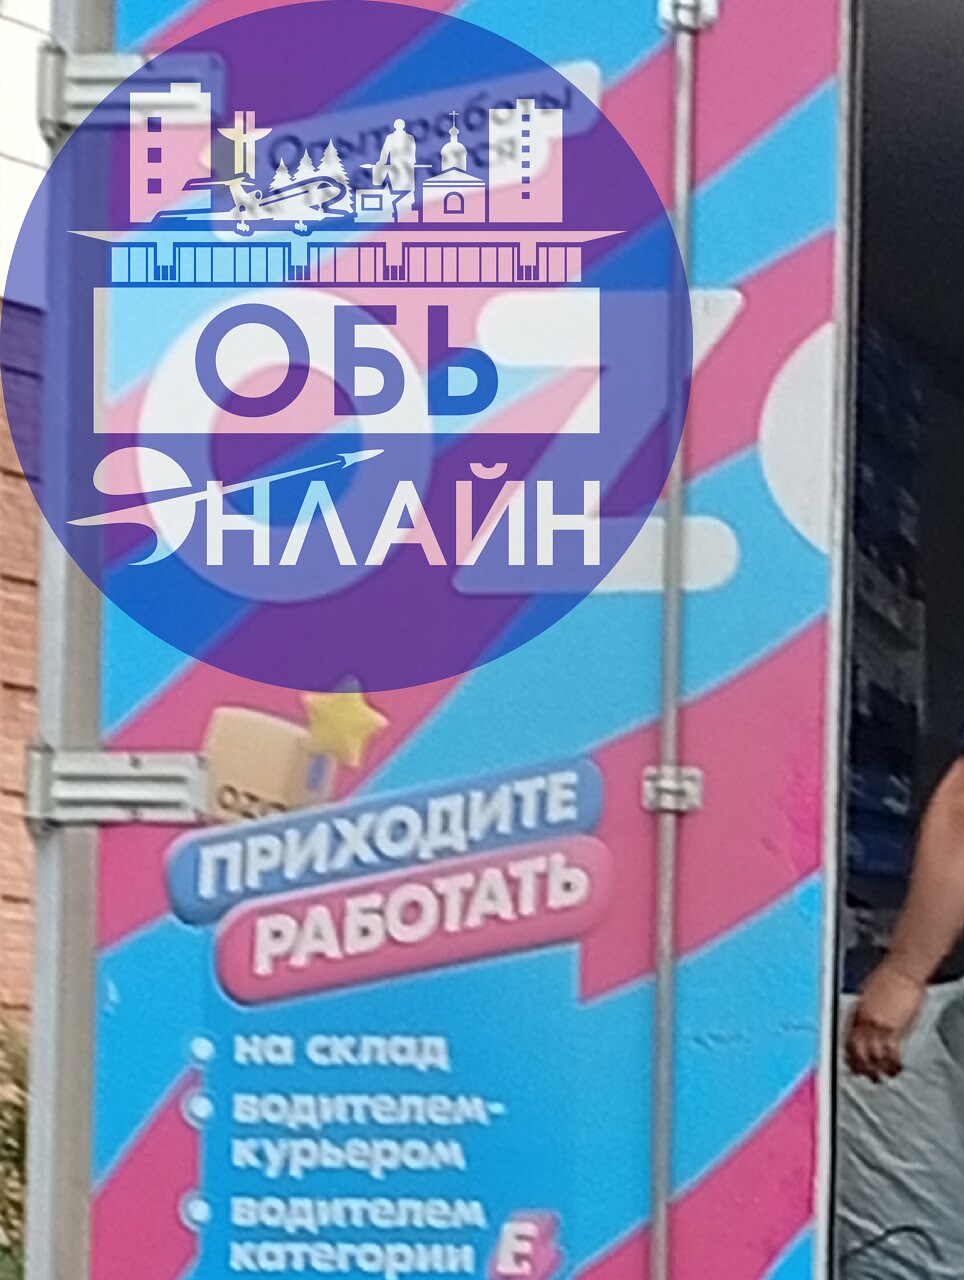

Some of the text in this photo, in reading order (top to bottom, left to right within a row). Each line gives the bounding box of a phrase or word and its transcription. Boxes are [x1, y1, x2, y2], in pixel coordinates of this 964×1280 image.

[197, 771, 578, 899] ПРИХОДИТЕ
[253, 851, 589, 976] РАБОТАТЬ
[233, 1034, 452, 1073] на склад
[232, 1092, 507, 1131] водителем-
[231, 1138, 467, 1181] курьером
[230, 1195, 488, 1235] водителем
